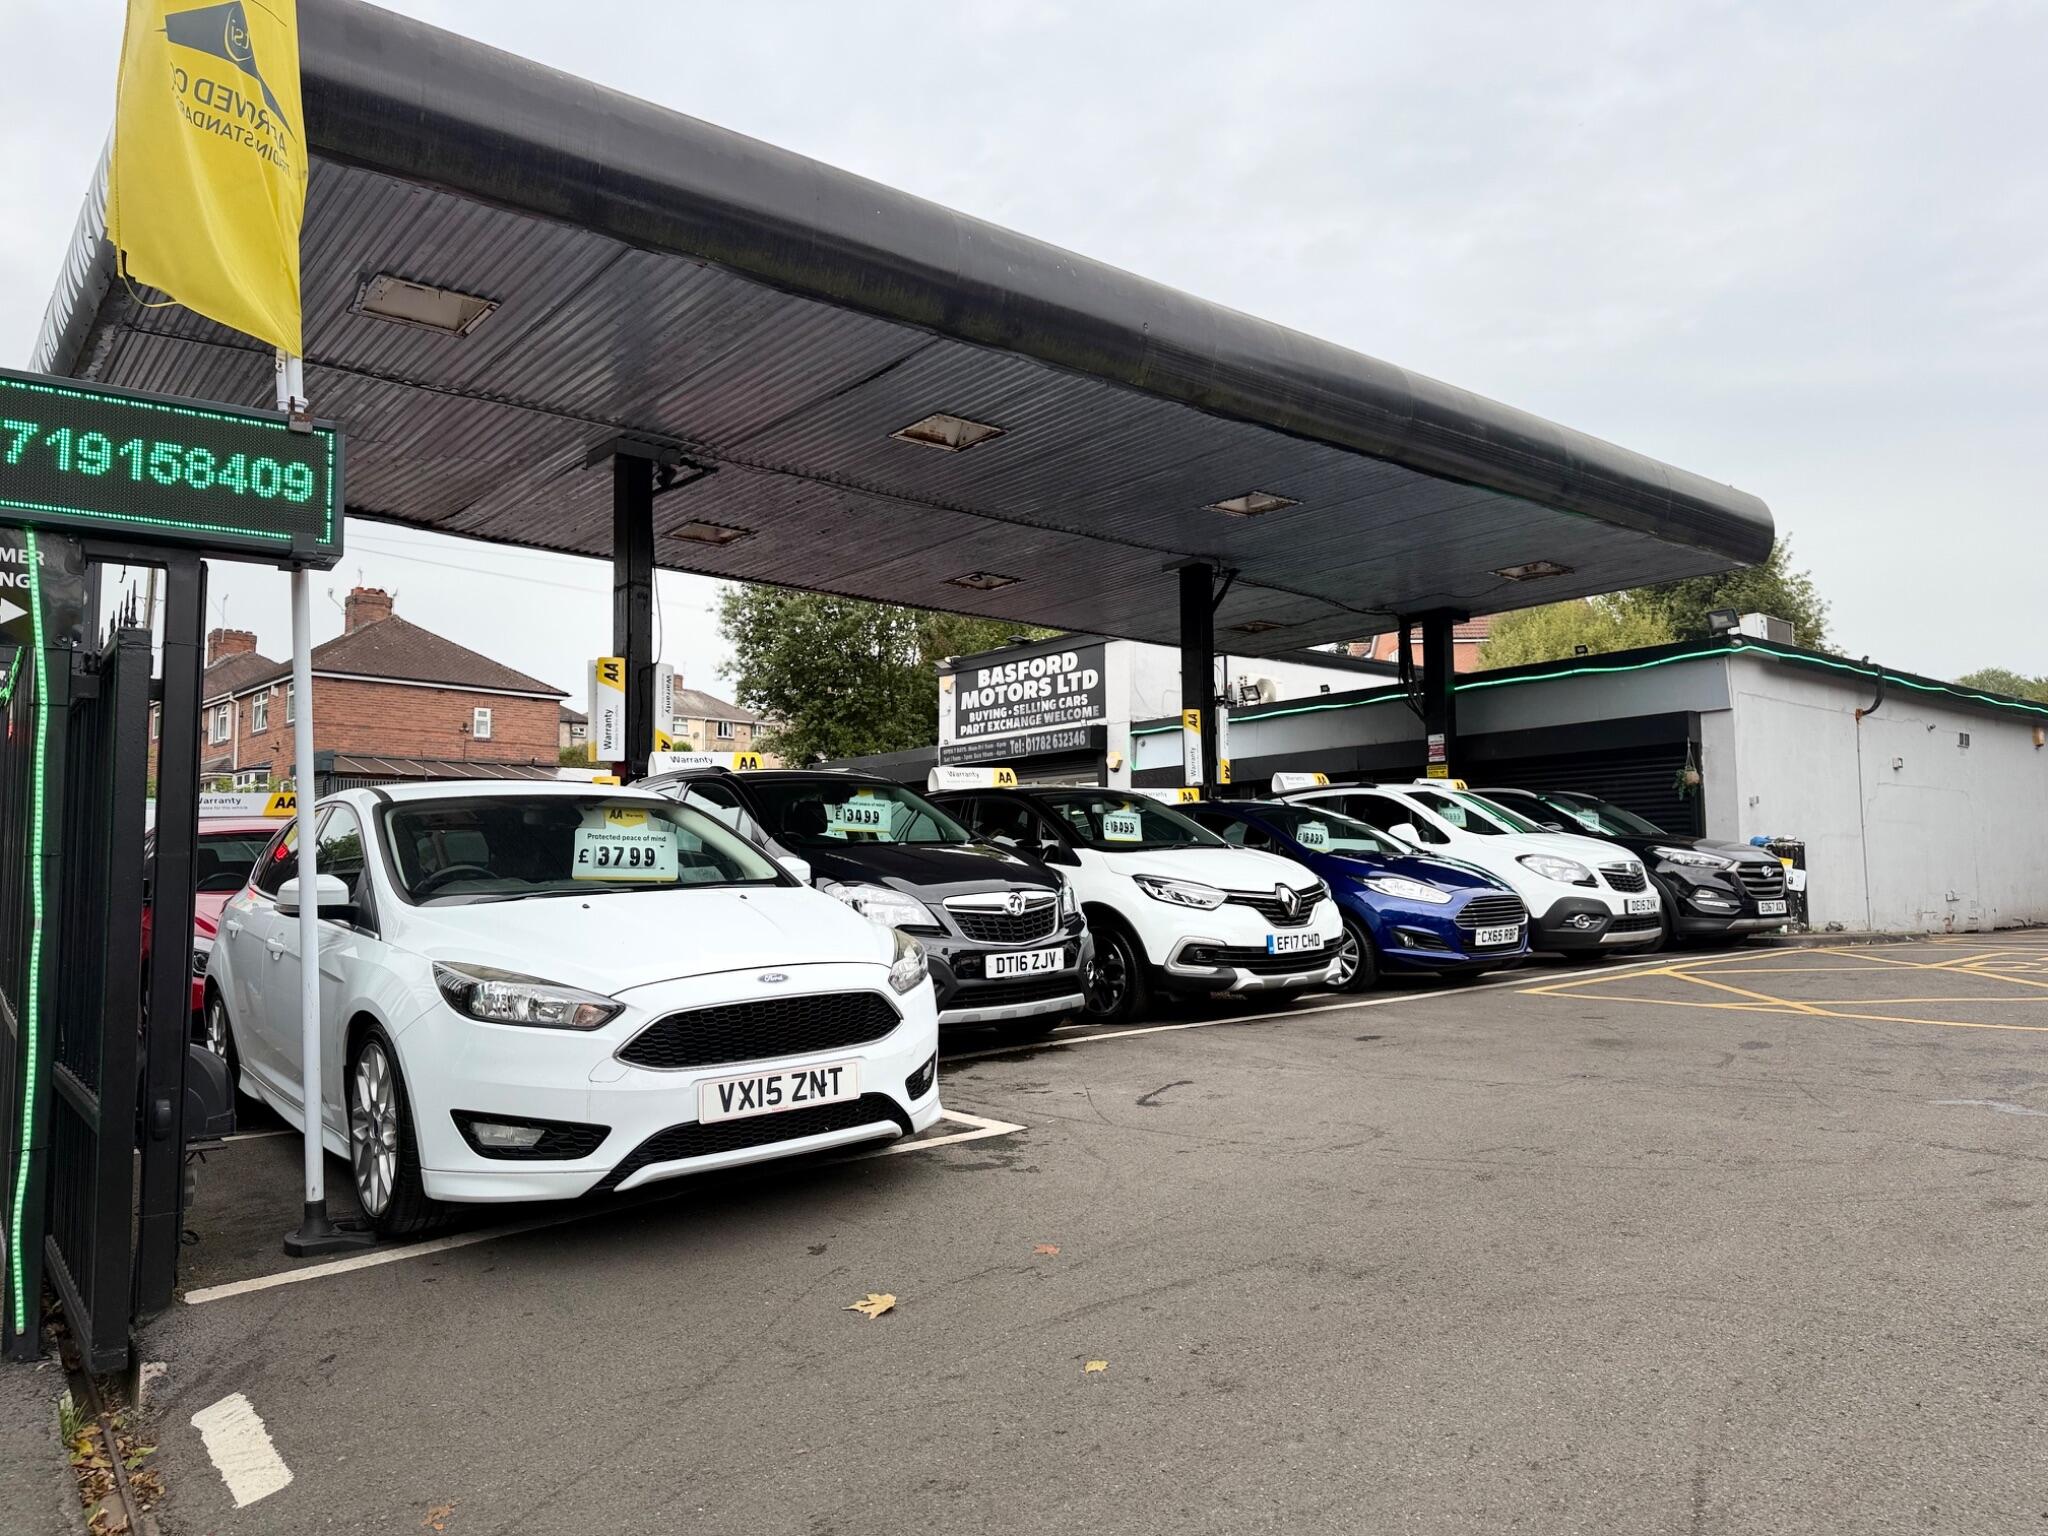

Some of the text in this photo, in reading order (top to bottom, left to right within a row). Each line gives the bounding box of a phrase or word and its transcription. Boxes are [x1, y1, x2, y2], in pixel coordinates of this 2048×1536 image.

[604, 662, 619, 683] AA
[978, 651, 1079, 688] BASFORD
[960, 669, 1099, 711] MOTORS LTD
[969, 694, 1088, 723] BUYING SELLING CARS
[960, 705, 1100, 736] PART EXCHANGE WELCOME
[1188, 713, 1198, 728] AA
[603, 709, 614, 751] Warranty
[1010, 730, 1086, 755] Tel: 01782 632346
[670, 756, 757, 769] Warranty AA
[999, 772, 1012, 783] AA
[274, 797, 297, 808] AA
[1182, 792, 1194, 801] AA
[609, 809, 623, 819] AA
[587, 833, 621, 841] Protected
[622, 834, 642, 842] peace
[642, 834, 650, 842] of
[1277, 933, 1320, 951] EF17 CHD
[1481, 929, 1503, 943] CX65
[996, 951, 1056, 974] DT16 ZJV
[763, 974, 784, 982] Ford
[718, 1066, 843, 1113] VX15 ZNT
